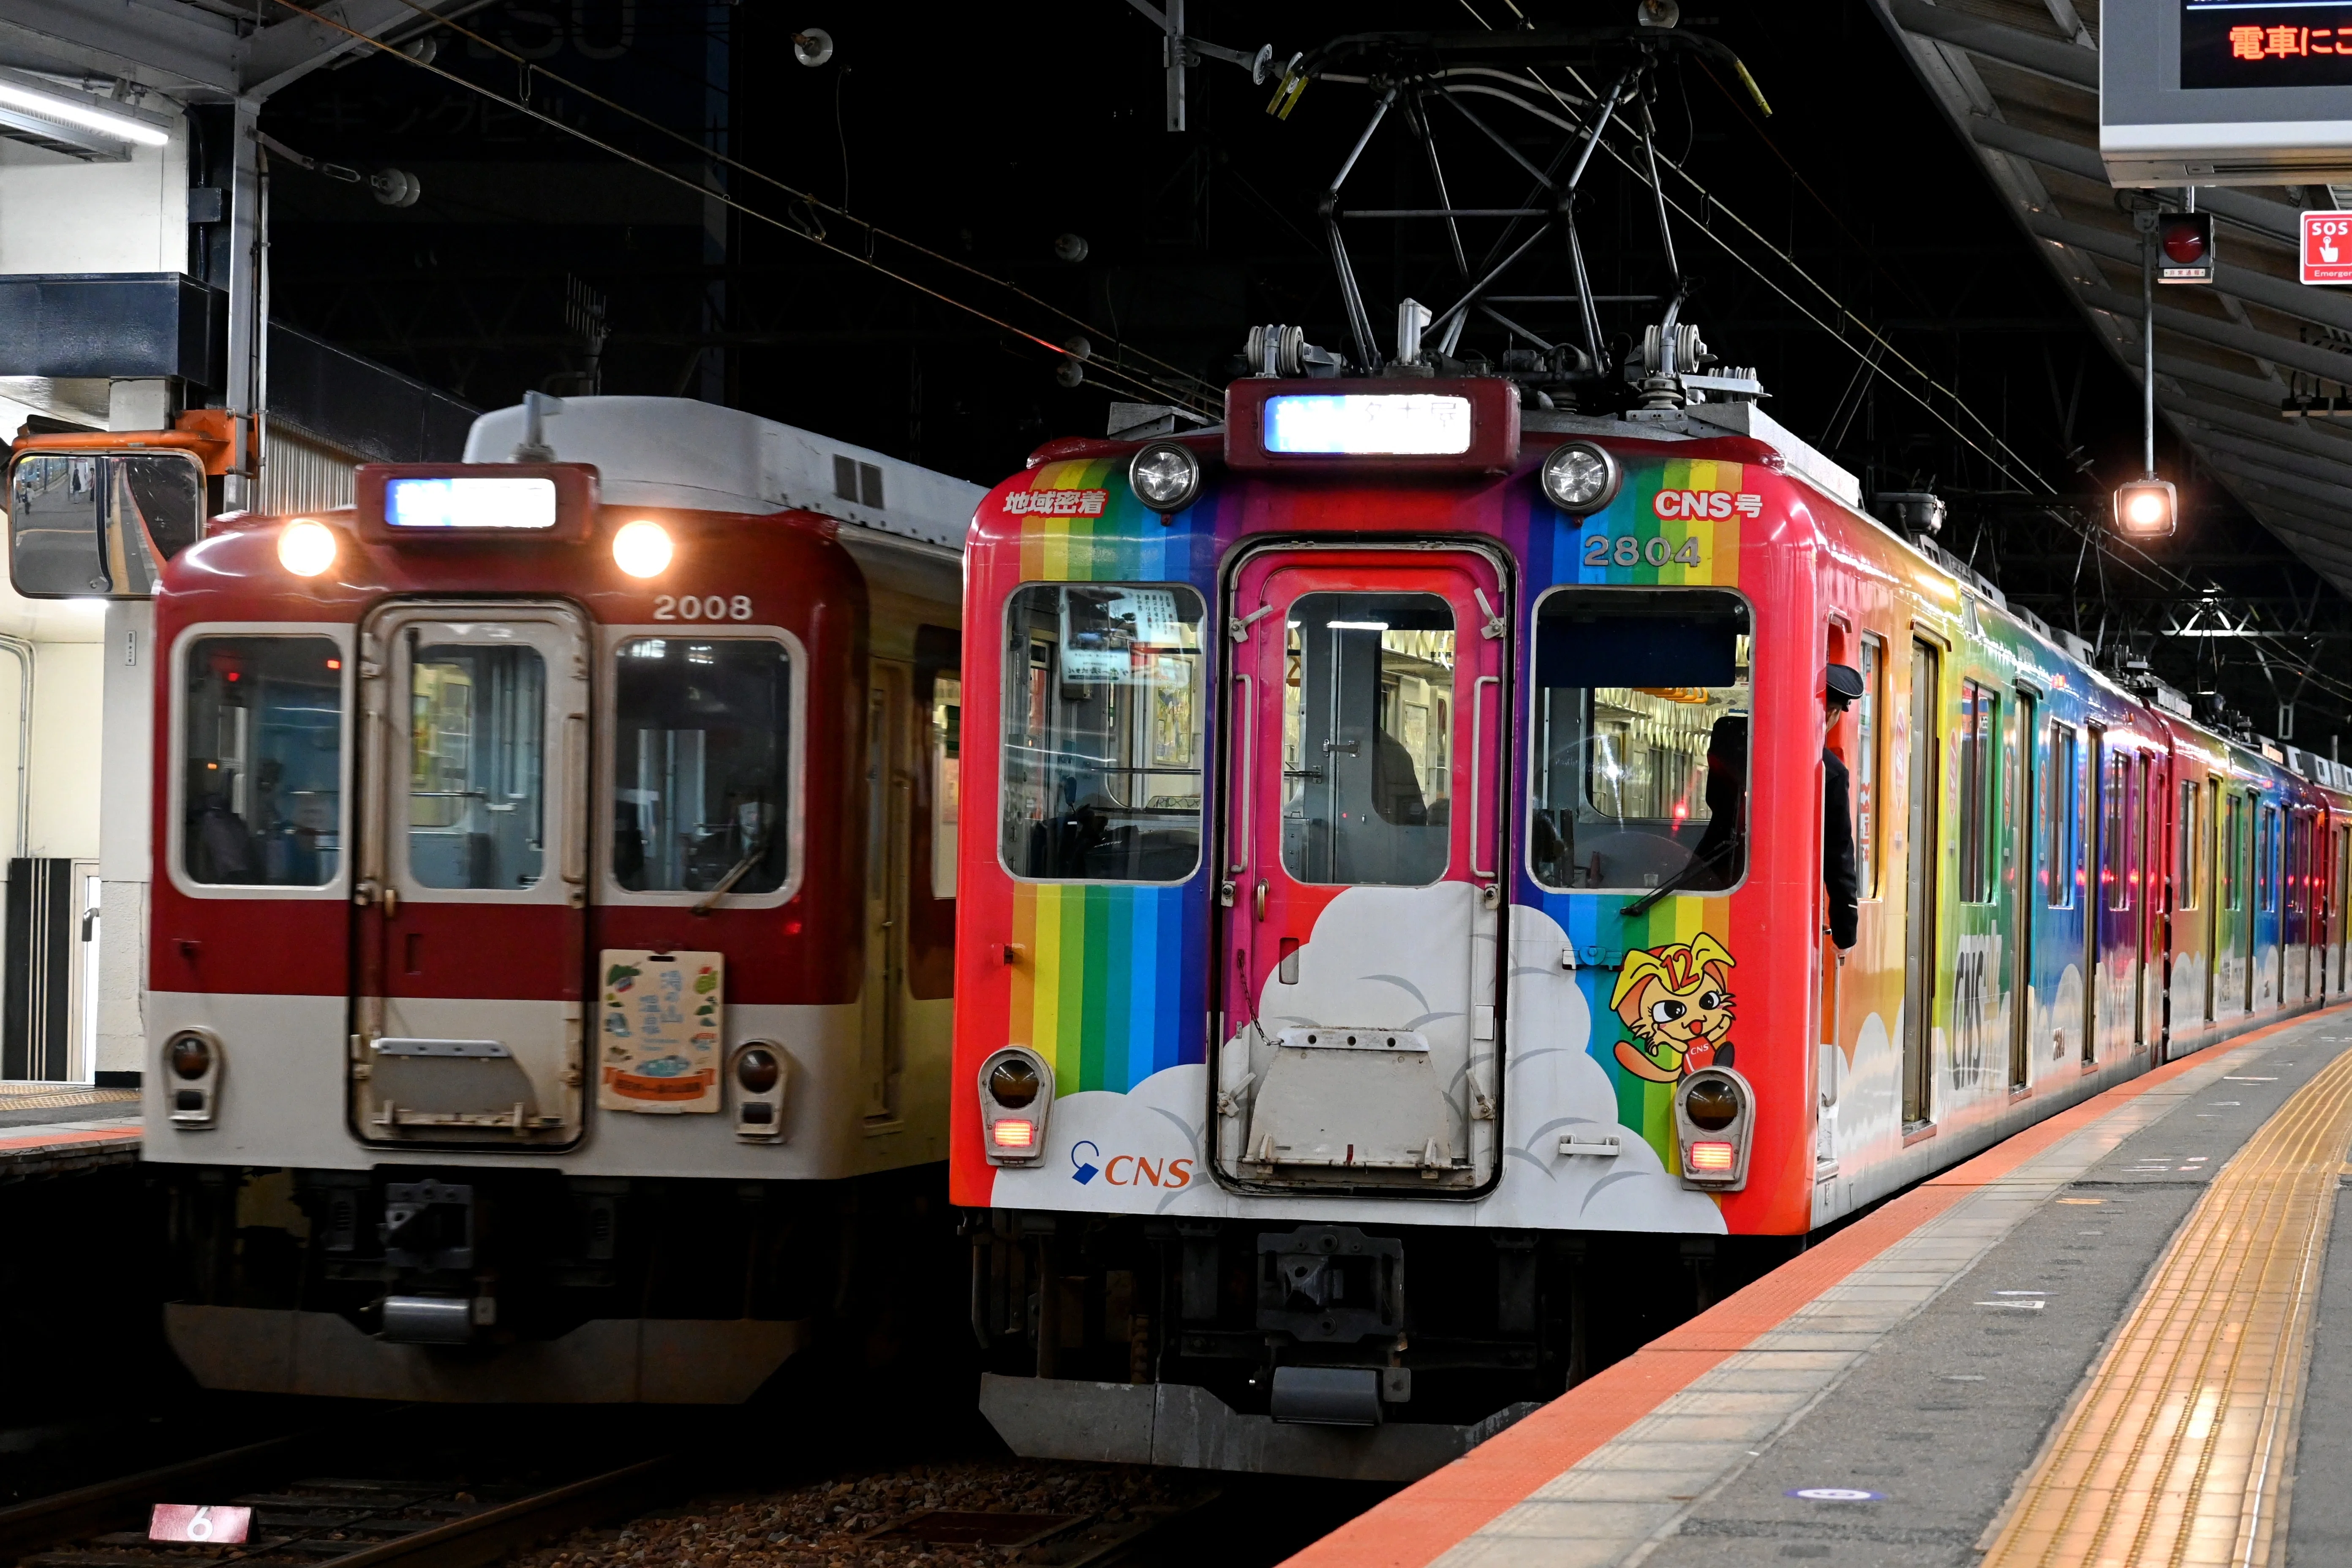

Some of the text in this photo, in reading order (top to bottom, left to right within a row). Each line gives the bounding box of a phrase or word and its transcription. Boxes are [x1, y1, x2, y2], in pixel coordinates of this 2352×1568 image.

[2311, 222, 2349, 236] SOS
[1003, 491, 1106, 514] 地域密着
[1655, 491, 1763, 518] CNS号
[1584, 535, 1701, 567] 2804
[653, 594, 753, 621] 2008
[1952, 950, 1984, 1090] CNS
[1690, 1043, 1710, 1055] CNS
[1105, 1155, 1193, 1188] CNS
[187, 1507, 213, 1541] 6
